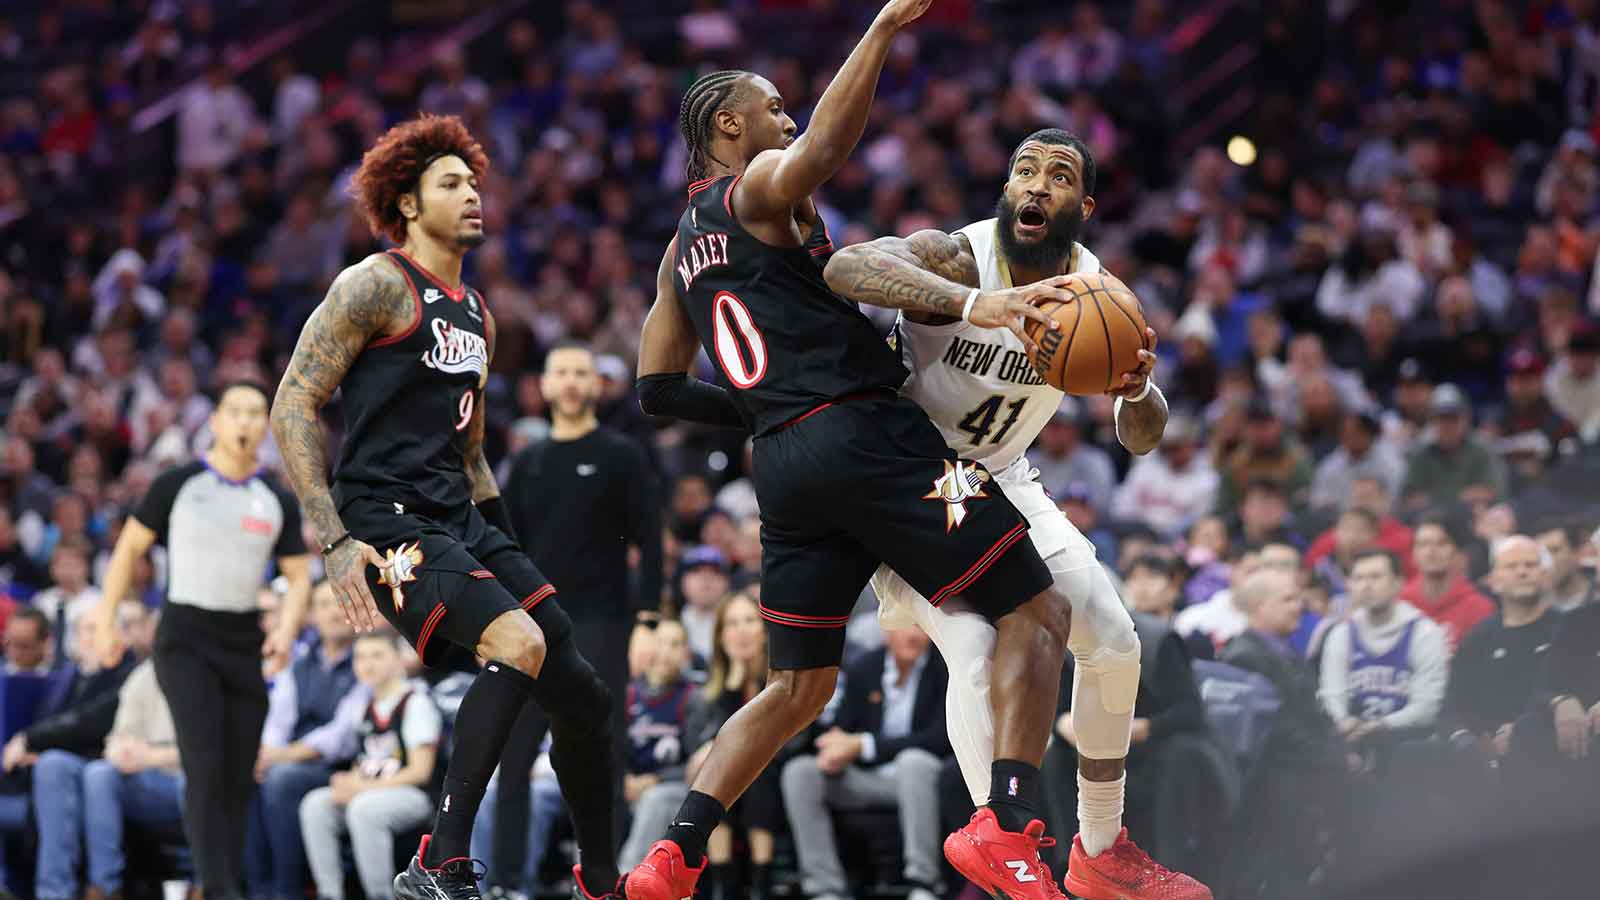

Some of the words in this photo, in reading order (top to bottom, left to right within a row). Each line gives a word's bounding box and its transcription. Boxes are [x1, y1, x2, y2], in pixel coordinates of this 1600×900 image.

[677, 232, 729, 292] MAXEY
[712, 290, 768, 389] 0
[942, 336, 1002, 376] NEW
[998, 350, 1047, 385] ORL
[455, 389, 474, 432] 9
[957, 394, 1031, 447] 41
